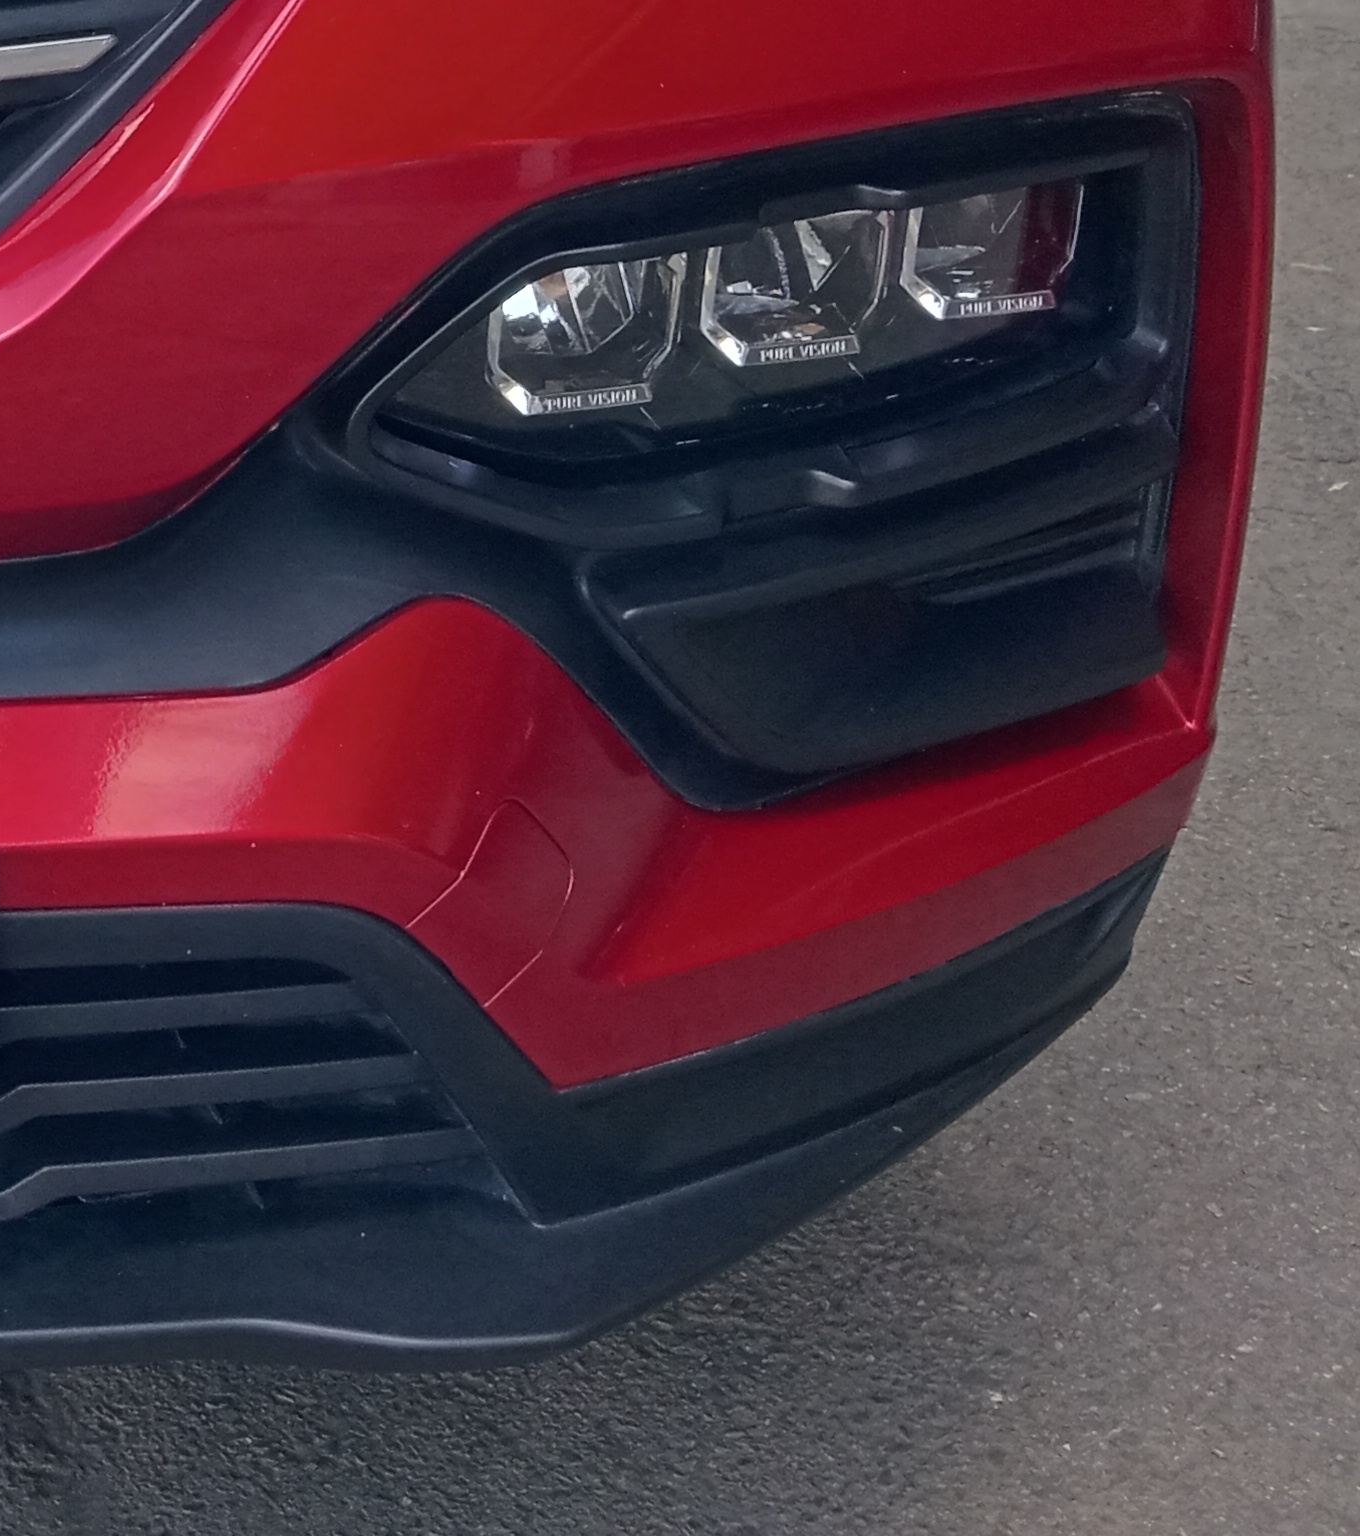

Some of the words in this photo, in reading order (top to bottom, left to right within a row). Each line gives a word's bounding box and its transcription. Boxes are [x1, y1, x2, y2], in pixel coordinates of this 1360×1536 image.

[997, 295, 1043, 311] VISION
[799, 340, 846, 357] VISION
[587, 389, 637, 405] VISION
